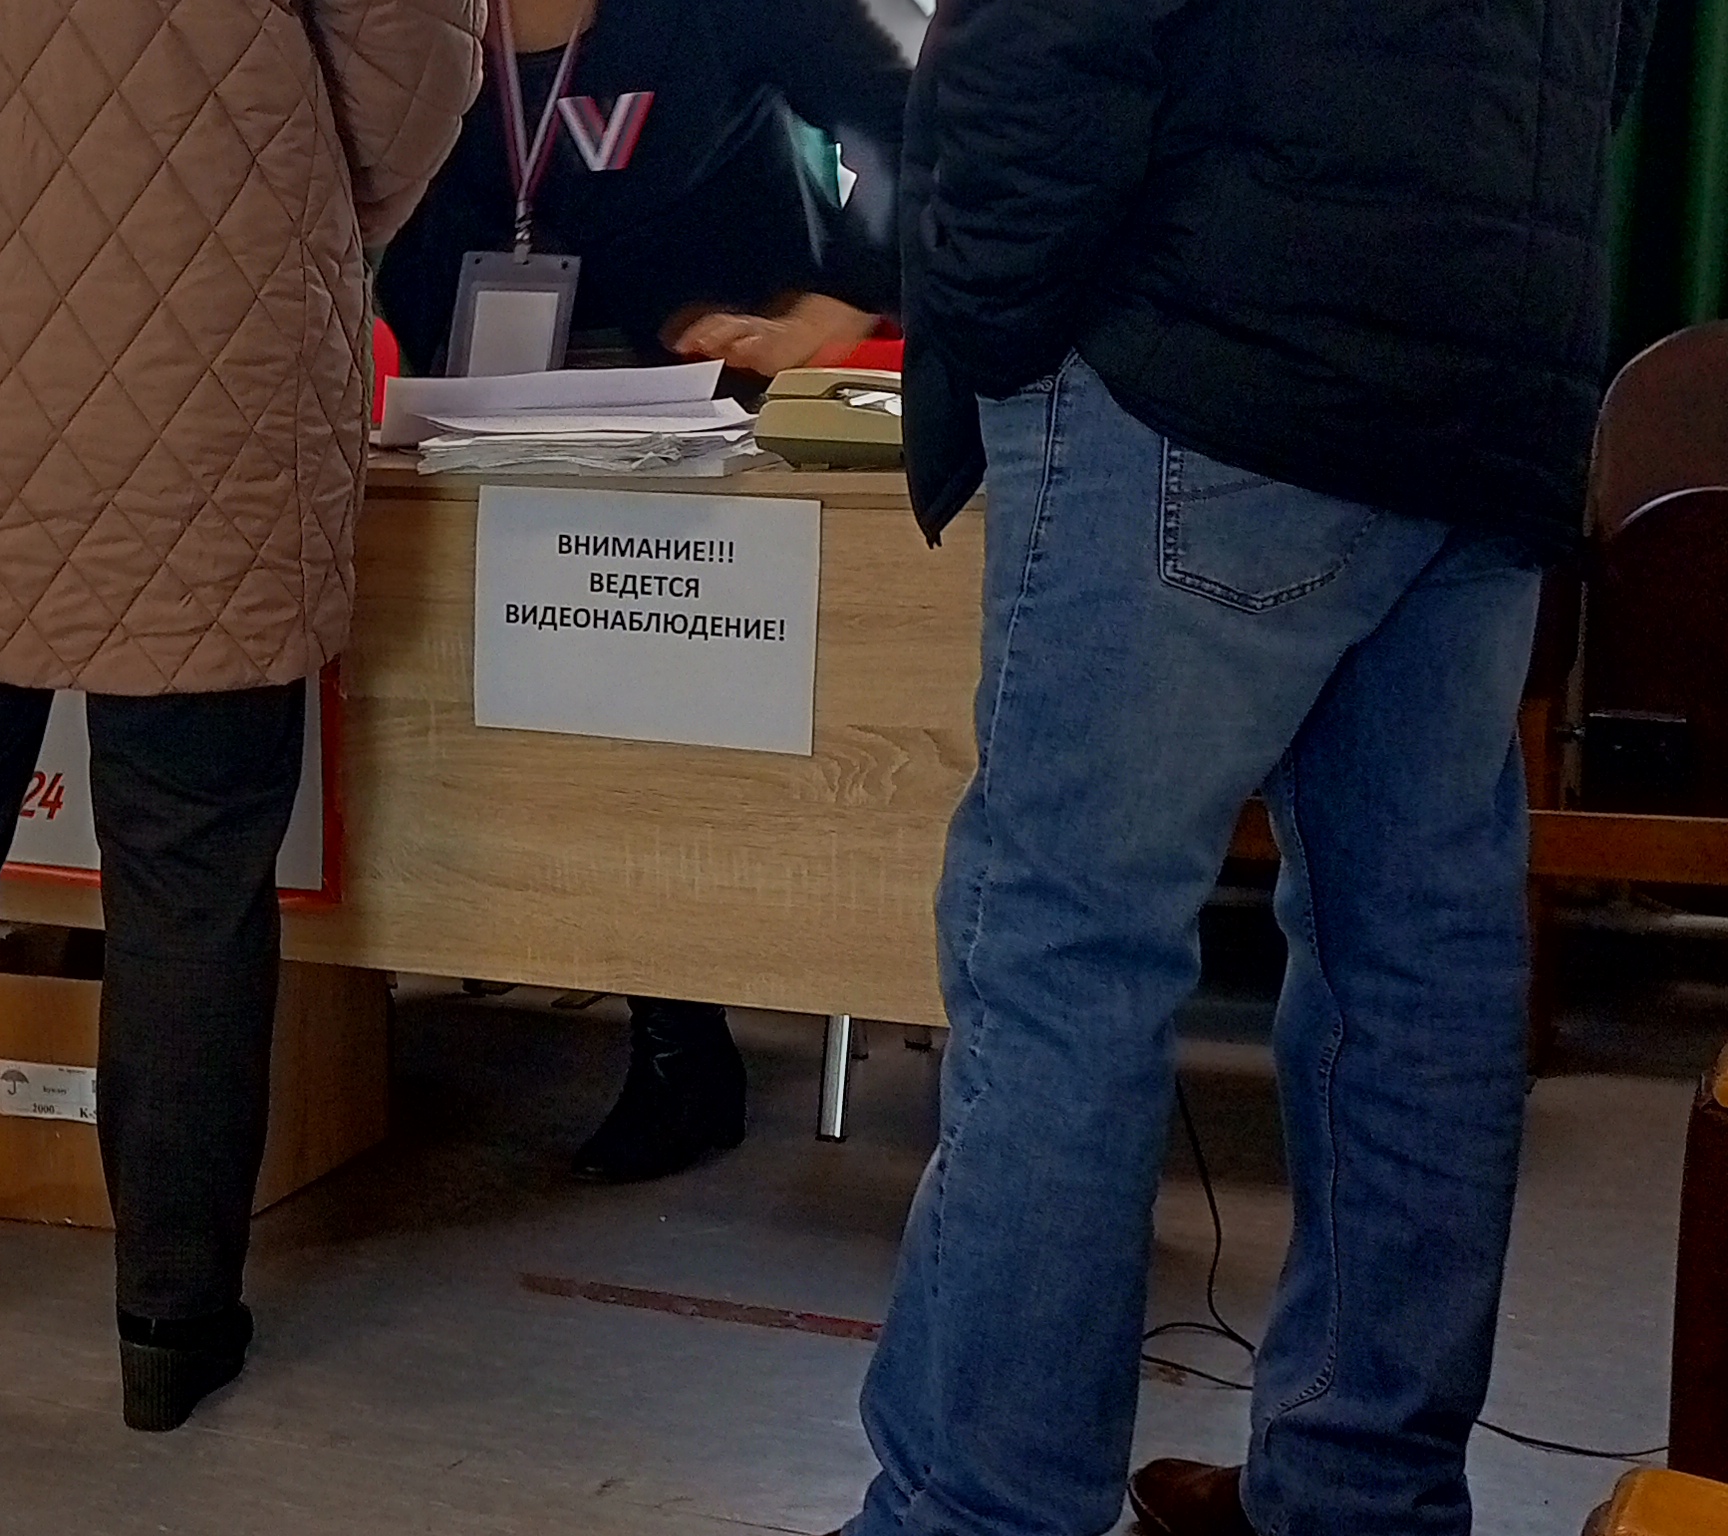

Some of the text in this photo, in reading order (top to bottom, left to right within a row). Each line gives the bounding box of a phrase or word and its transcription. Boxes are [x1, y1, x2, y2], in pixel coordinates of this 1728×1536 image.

[557, 534, 735, 563] ВНИМАНИЕ!!!
[589, 573, 700, 599] ВЕДЕТСЯ
[505, 604, 786, 641] ВИДЕОНАБЛЮДЕНИЕ!
